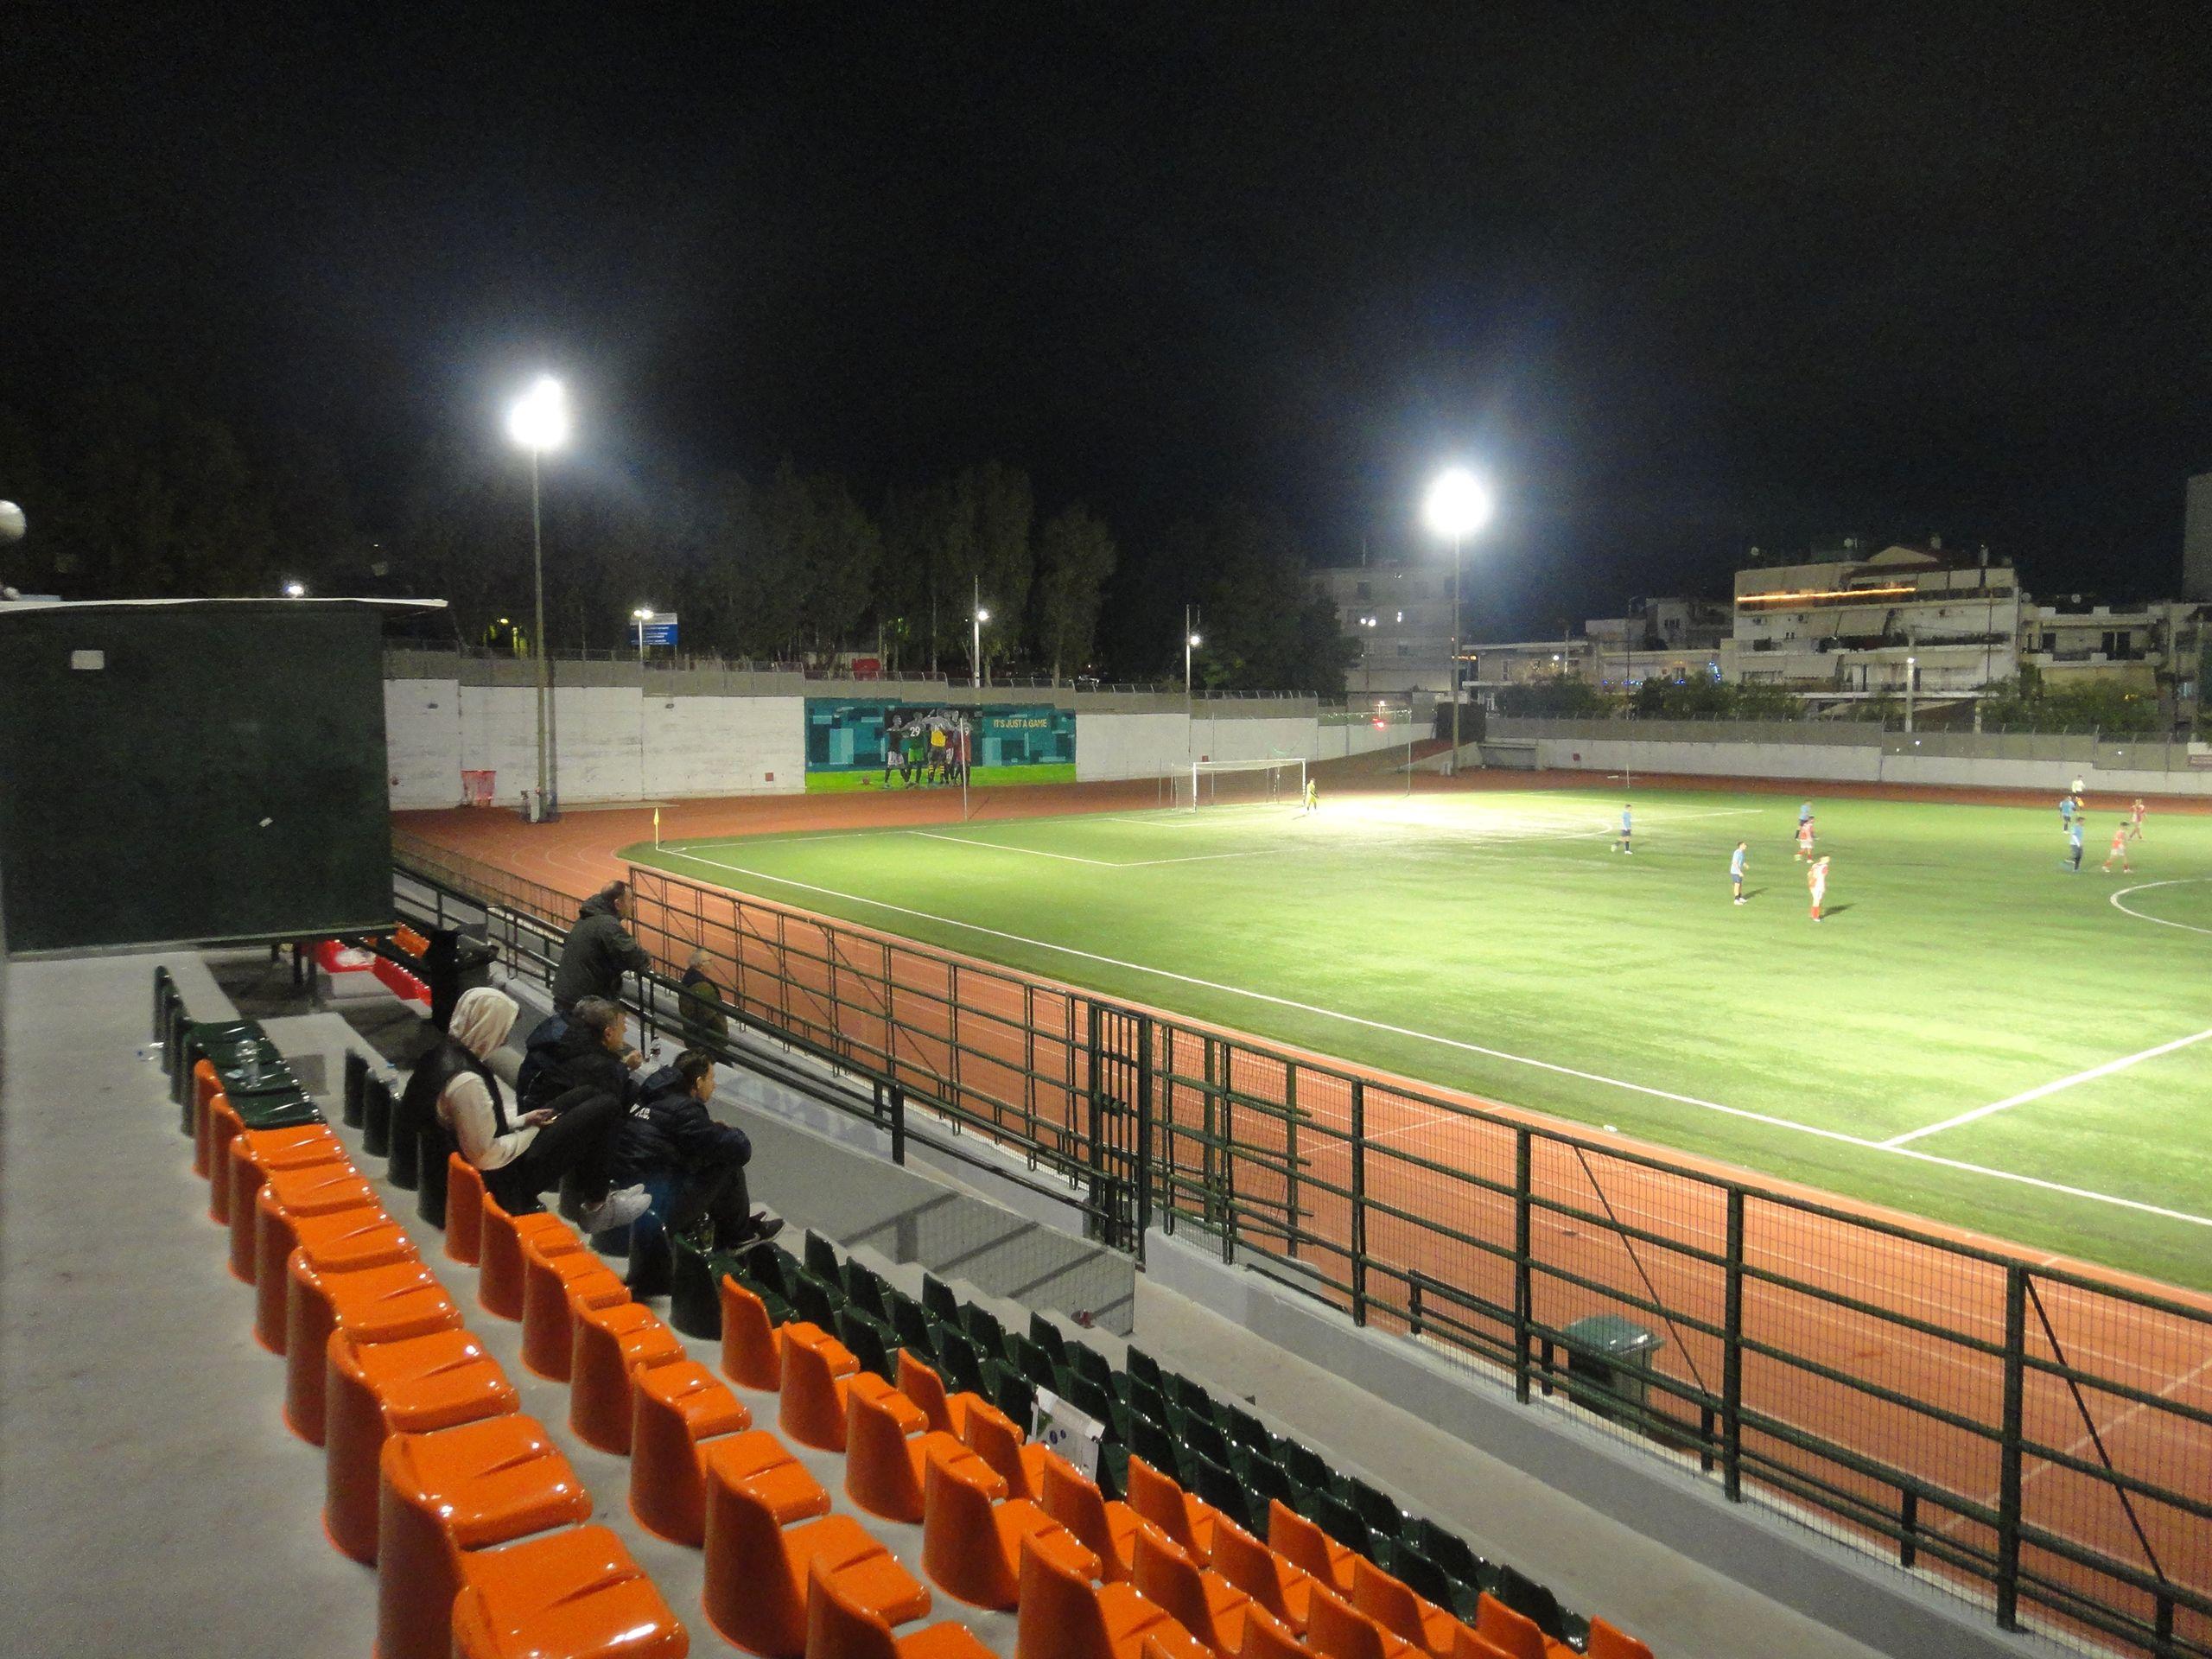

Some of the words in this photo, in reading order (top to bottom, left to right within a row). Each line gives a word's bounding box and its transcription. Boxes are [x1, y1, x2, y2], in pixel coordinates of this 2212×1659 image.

[994, 719, 1005, 728] IT'S
[1006, 719, 1022, 728] JUST
[1022, 719, 1028, 728] A
[1028, 719, 1046, 728] GAME
[910, 727, 920, 736] 29
